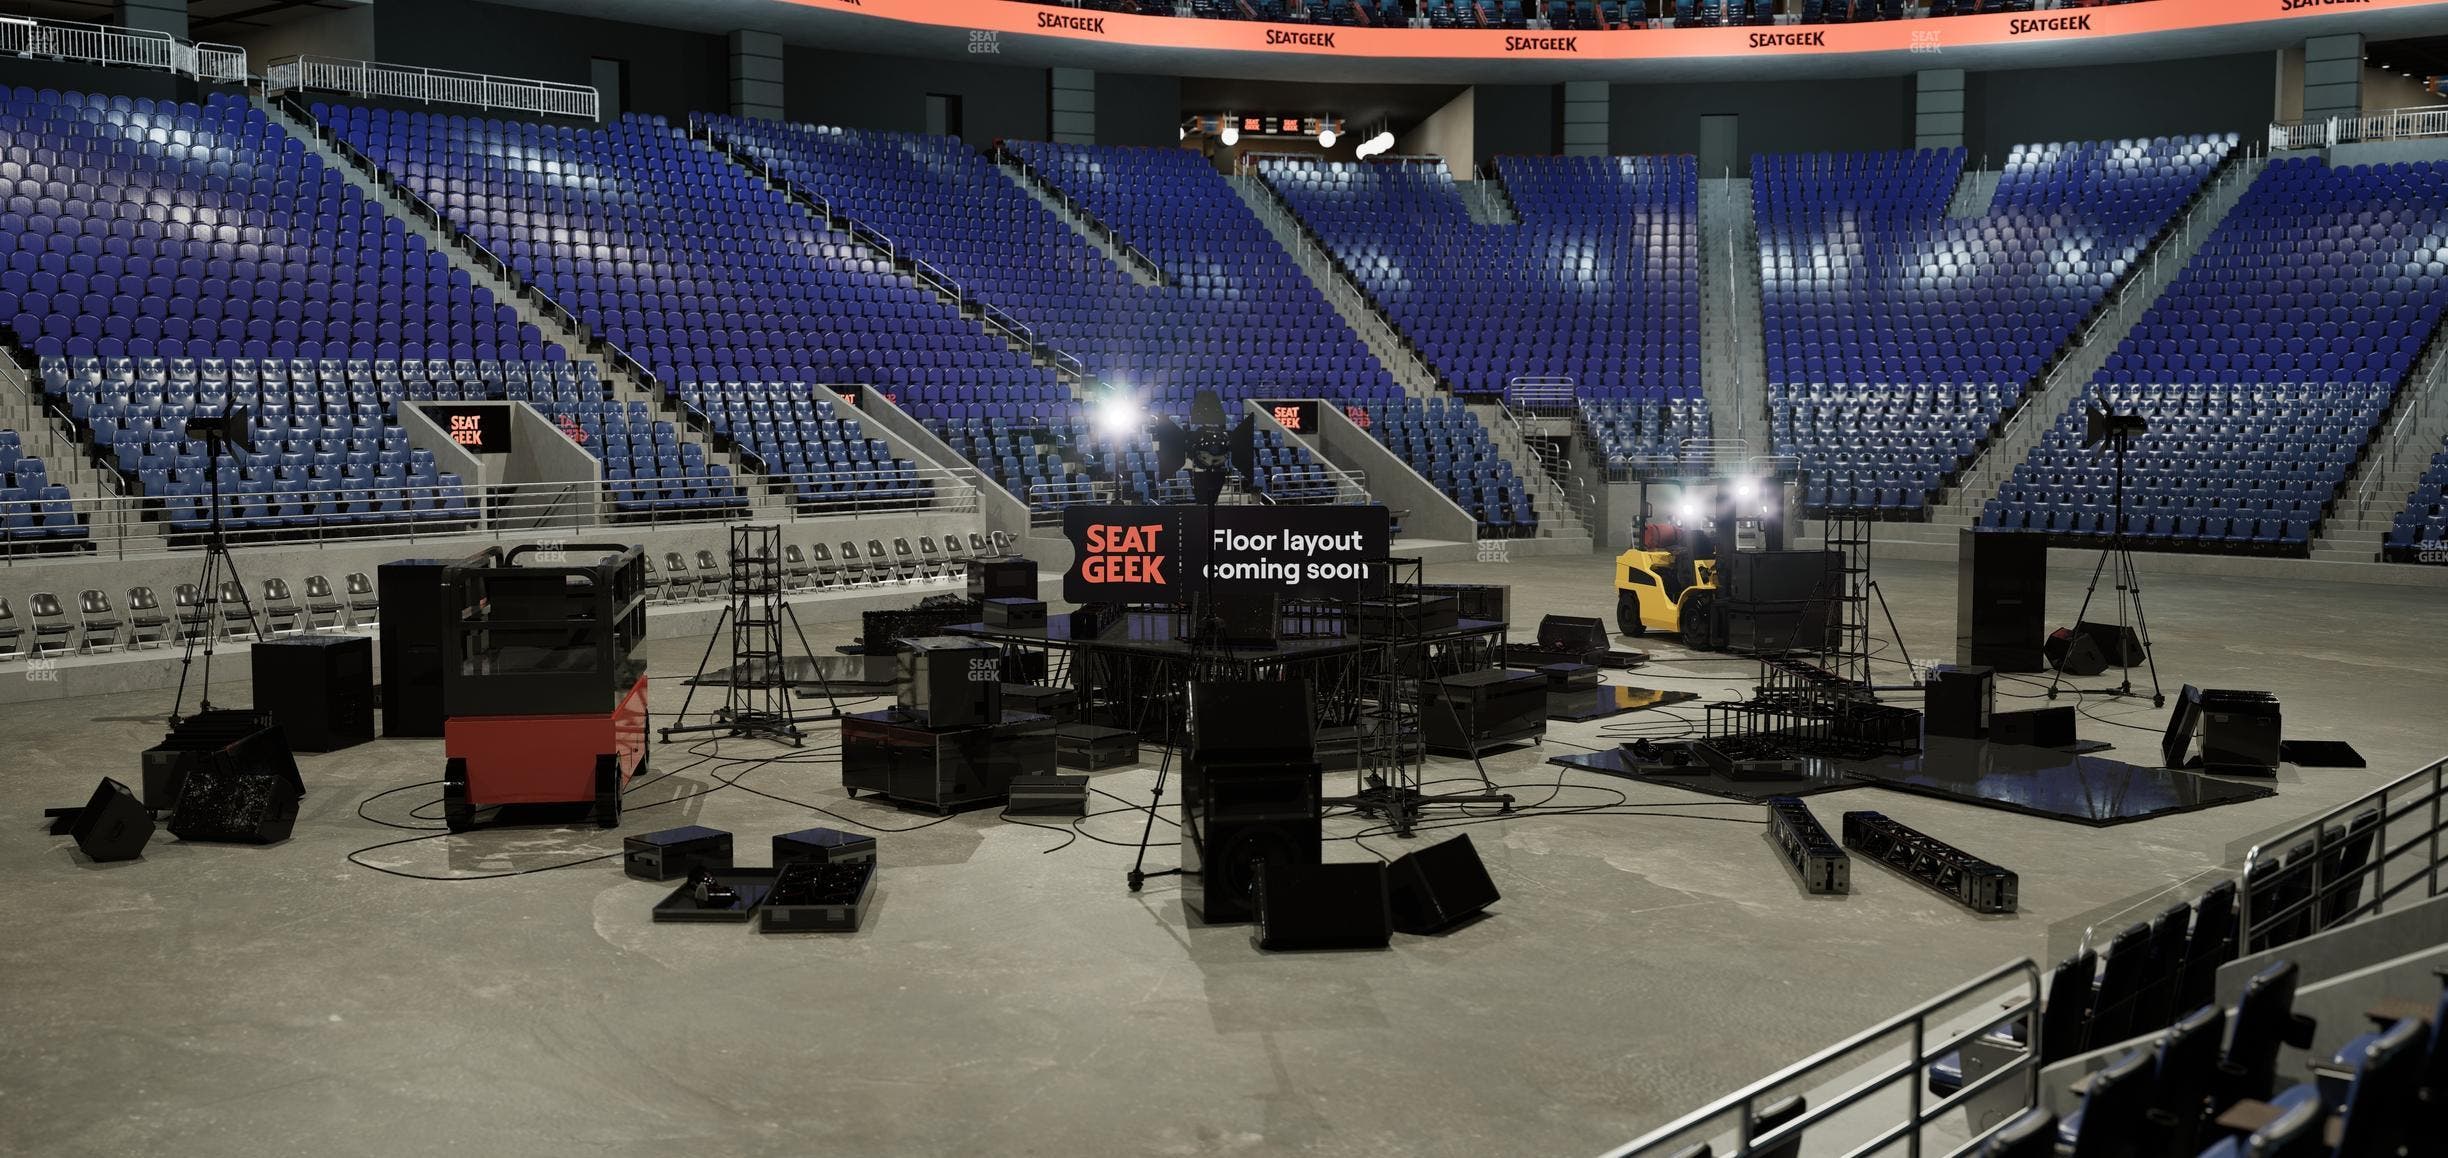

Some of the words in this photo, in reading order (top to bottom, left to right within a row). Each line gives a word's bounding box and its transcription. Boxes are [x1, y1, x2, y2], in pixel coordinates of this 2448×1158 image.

[1038, 12, 1105, 34] SEATGEEK
[2010, 14, 2091, 35] SEATGEEK
[1266, 29, 1335, 48] SEATGEEK
[1505, 36, 1577, 52] SEATGEEK
[1749, 31, 1825, 48] SEATGEEK
[451, 415, 480, 430] SEAT
[1274, 407, 1299, 418] SEAT
[1086, 524, 1164, 553] SEAT
[1213, 529, 1277, 551] Floor
[1283, 529, 1363, 556] layout
[1081, 554, 1167, 585] GEEK
[1203, 557, 1300, 585] coming
[1306, 563, 1369, 579] soon
